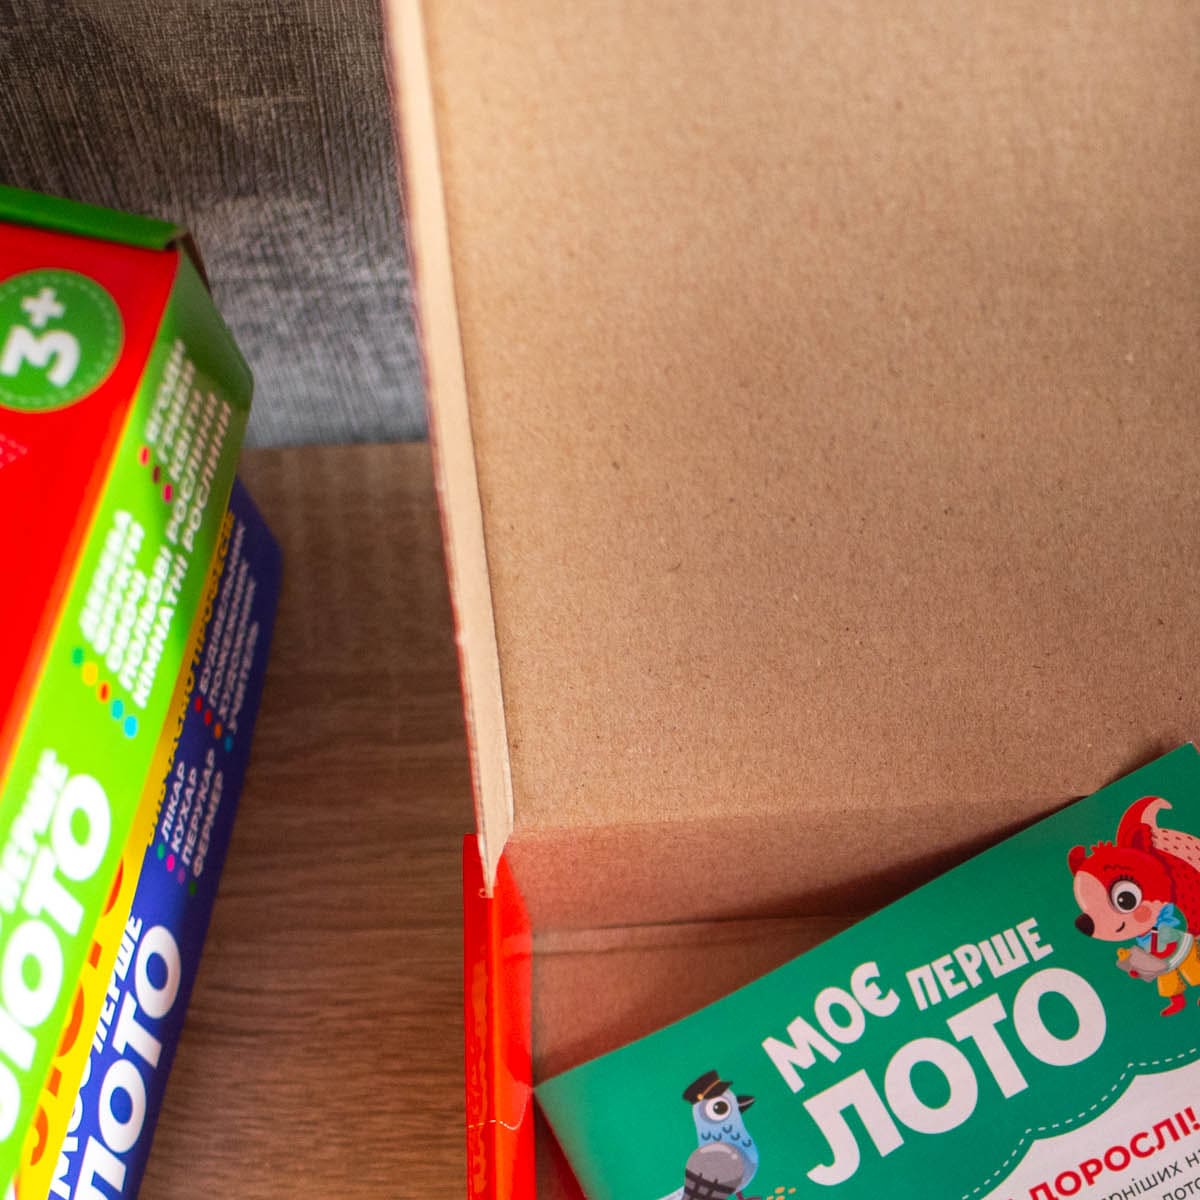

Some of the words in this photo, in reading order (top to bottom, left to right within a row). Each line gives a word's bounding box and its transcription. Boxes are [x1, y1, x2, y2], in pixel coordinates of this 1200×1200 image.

[1, 286, 81, 388] 3+
[118, 546, 172, 692] ПОЛЬОВІ
[166, 392, 218, 545] РОСЛИНИ
[132, 554, 188, 710] КІМНАТНІ
[182, 400, 231, 553] РОСЛИНИ
[162, 761, 185, 842] ЛІКАР
[171, 767, 197, 854] КУХАР
[181, 748, 215, 866] ПЕРУКАР
[193, 771, 223, 878] ФЕРМЕР
[761, 961, 900, 1094] МОЄ
[905, 917, 1054, 1011] ПЕРШЕ
[803, 967, 1107, 1187] ЛОТО
